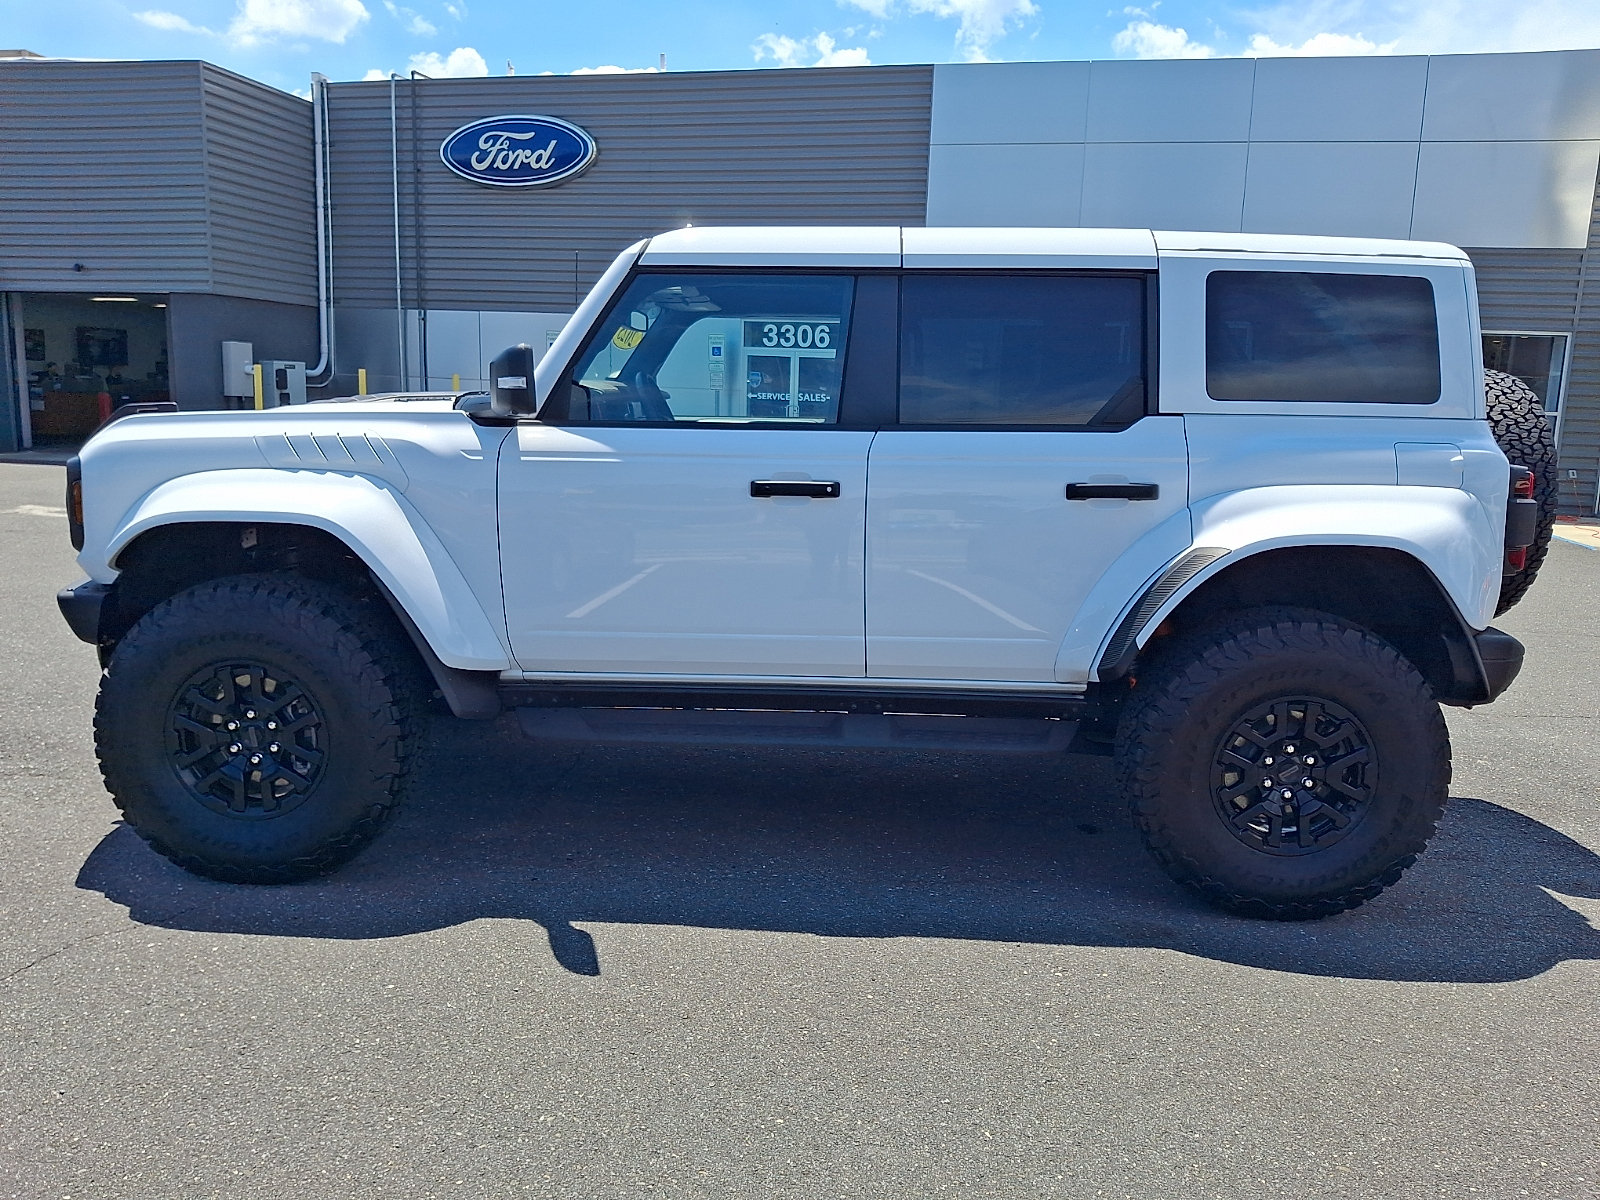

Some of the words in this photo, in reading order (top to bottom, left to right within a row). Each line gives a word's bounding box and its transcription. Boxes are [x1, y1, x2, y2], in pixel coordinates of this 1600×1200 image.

[471, 131, 557, 170] Ford
[762, 324, 831, 348] 3306
[757, 392, 790, 401] SERVICE
[798, 393, 826, 402] SALES
